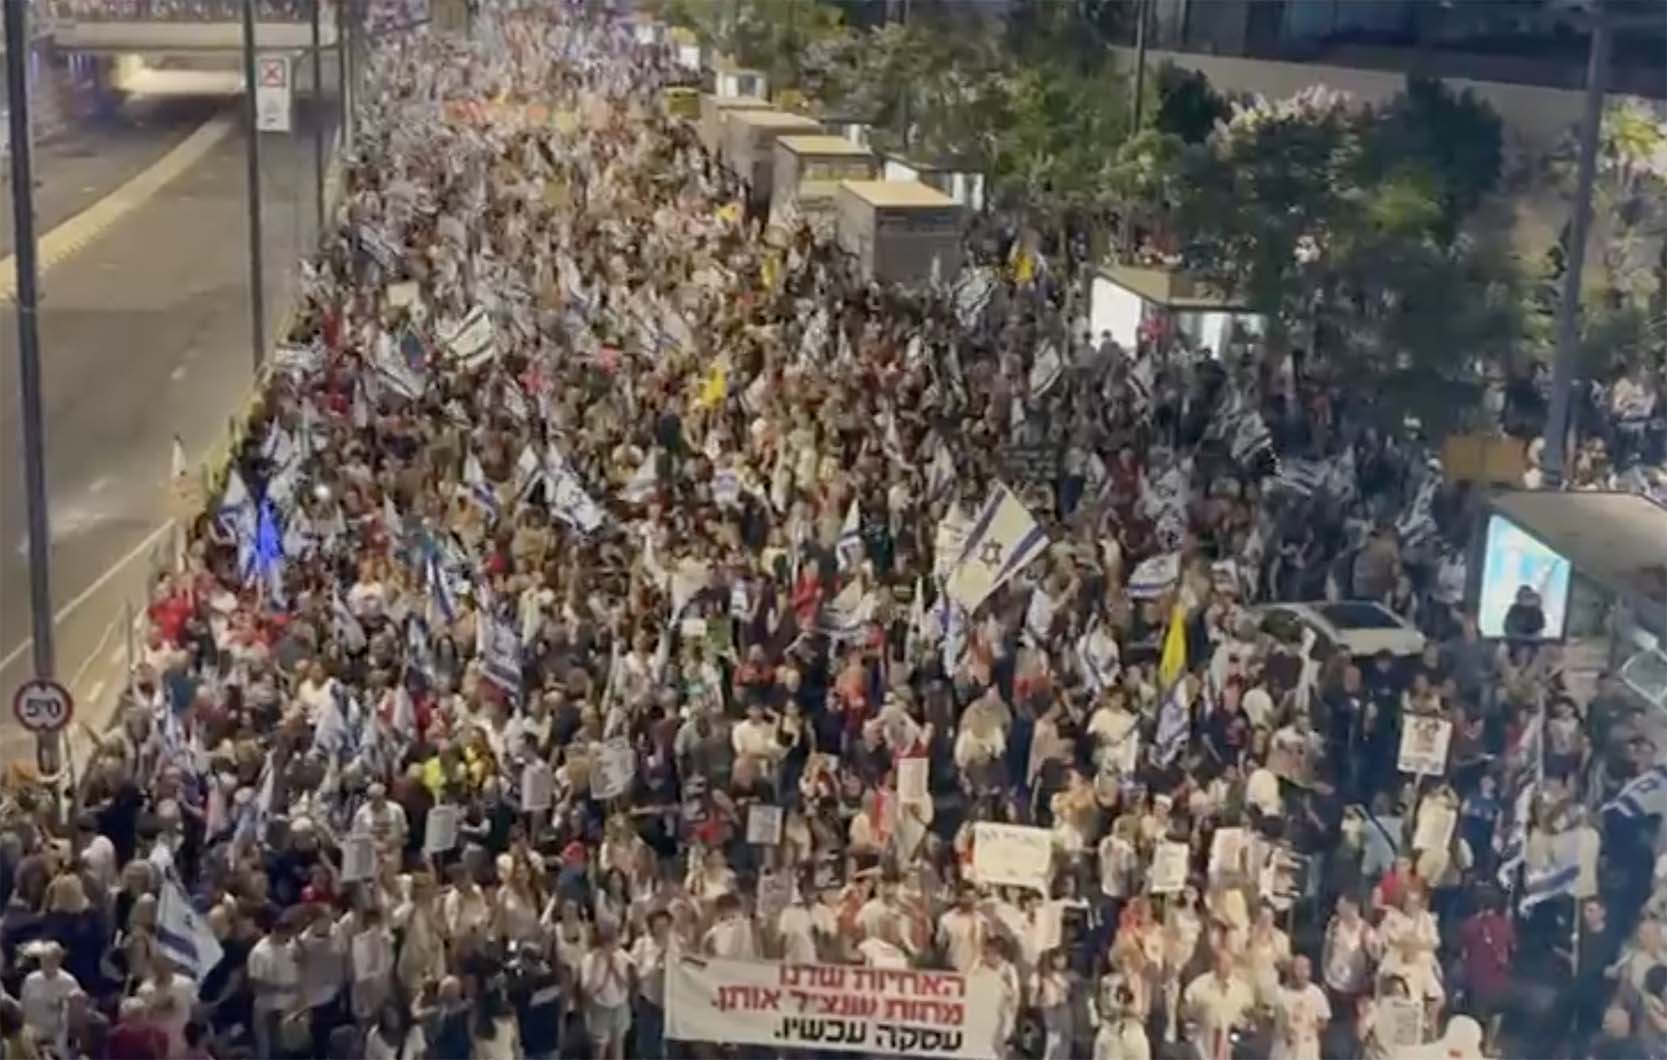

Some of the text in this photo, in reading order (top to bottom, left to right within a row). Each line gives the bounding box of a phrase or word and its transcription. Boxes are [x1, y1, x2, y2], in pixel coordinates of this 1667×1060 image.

[26, 698, 61, 718] 50
[853, 968, 966, 996] האחיות
[774, 1016, 962, 1052] עסקה עכשיו.
